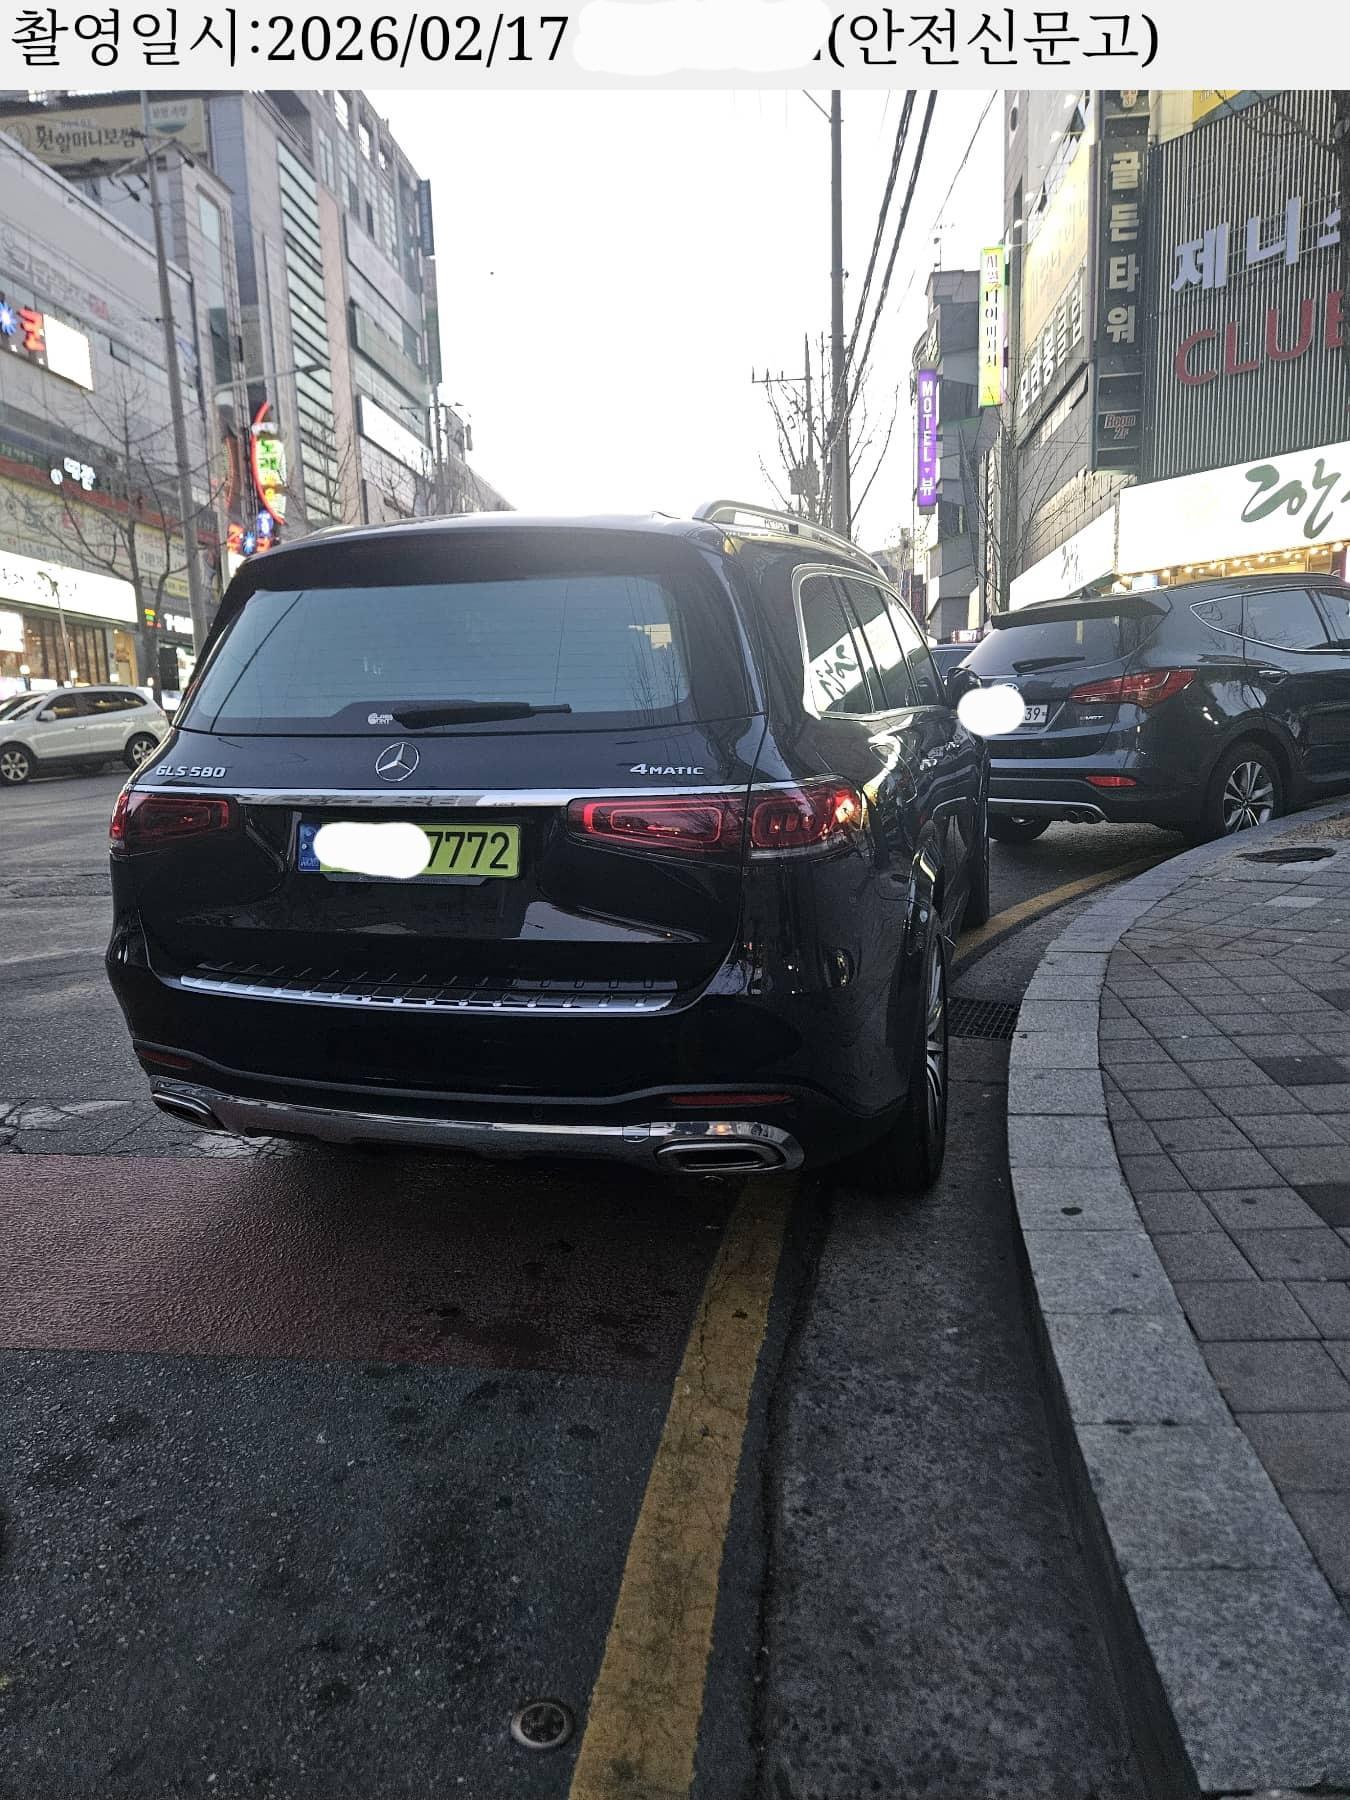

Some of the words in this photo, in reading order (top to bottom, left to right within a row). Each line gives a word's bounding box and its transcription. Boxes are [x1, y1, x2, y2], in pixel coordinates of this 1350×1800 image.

[1106, 150, 1140, 344] 골든타워
[922, 380, 934, 462] MOTEL
[1025, 707, 1041, 721] 39
[156, 764, 187, 776] GLS
[190, 767, 226, 778] 580
[630, 763, 704, 775] 4MATIC
[427, 831, 510, 869] 7772
